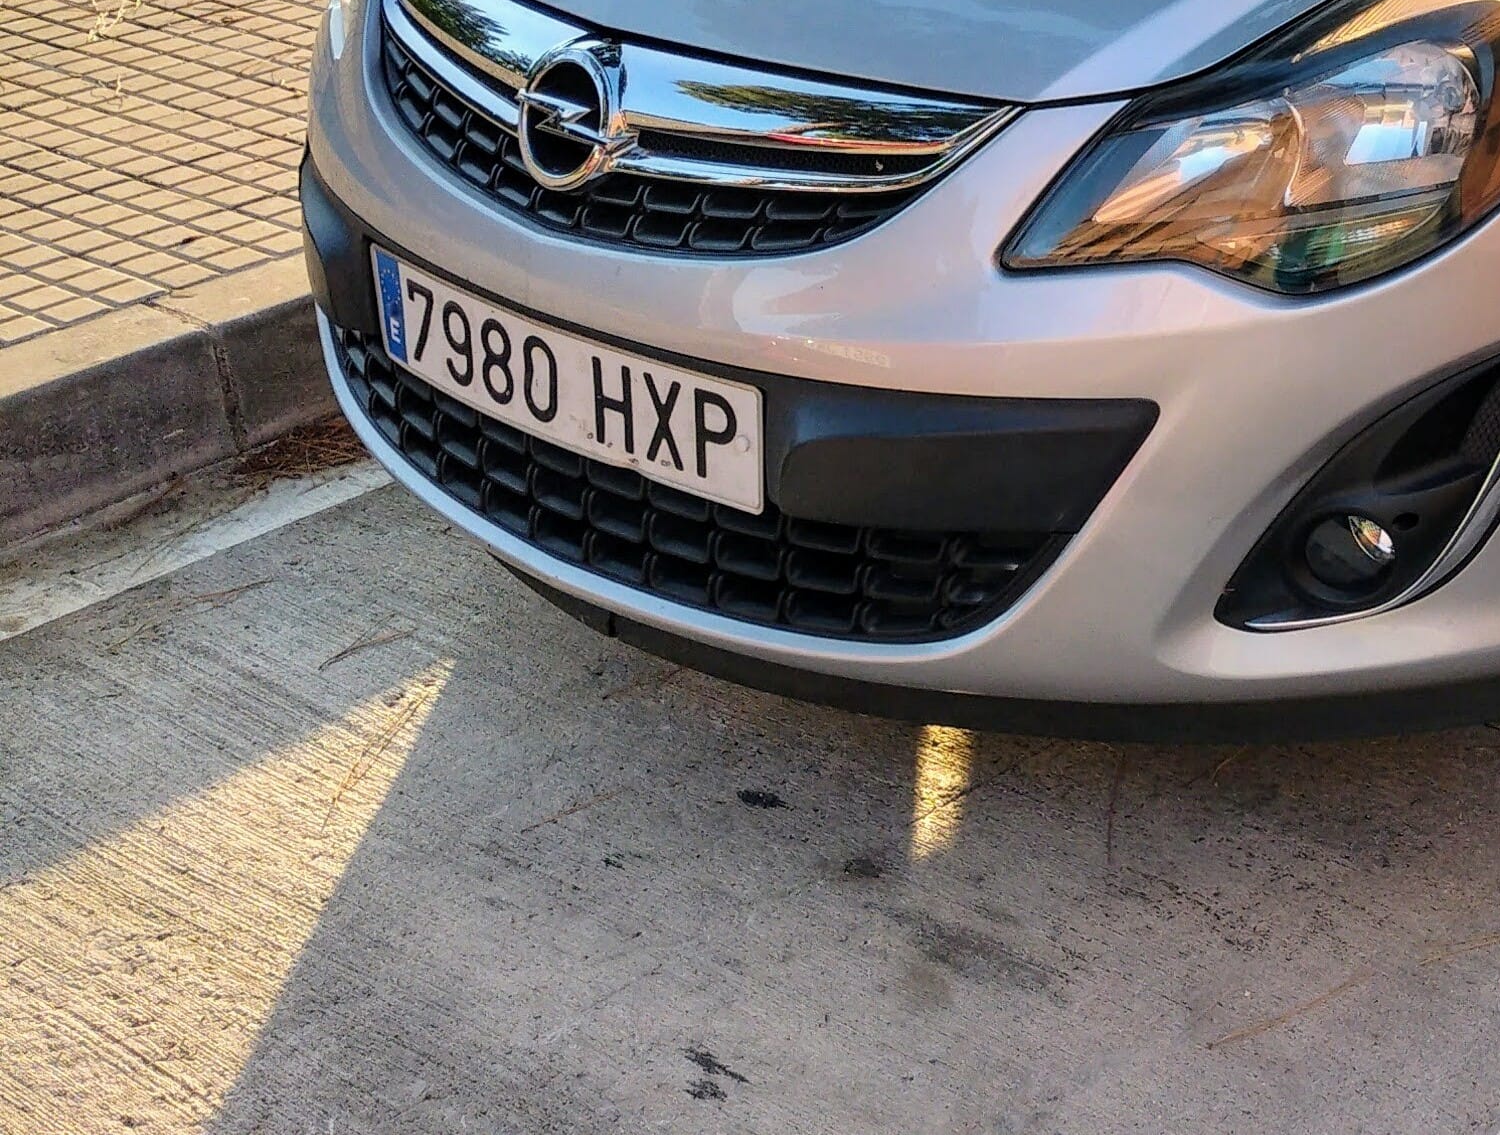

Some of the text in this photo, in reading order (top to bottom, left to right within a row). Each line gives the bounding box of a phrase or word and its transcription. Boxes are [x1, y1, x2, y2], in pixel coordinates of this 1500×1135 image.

[390, 316, 401, 345] E
[406, 278, 738, 478] 7980 HXP
